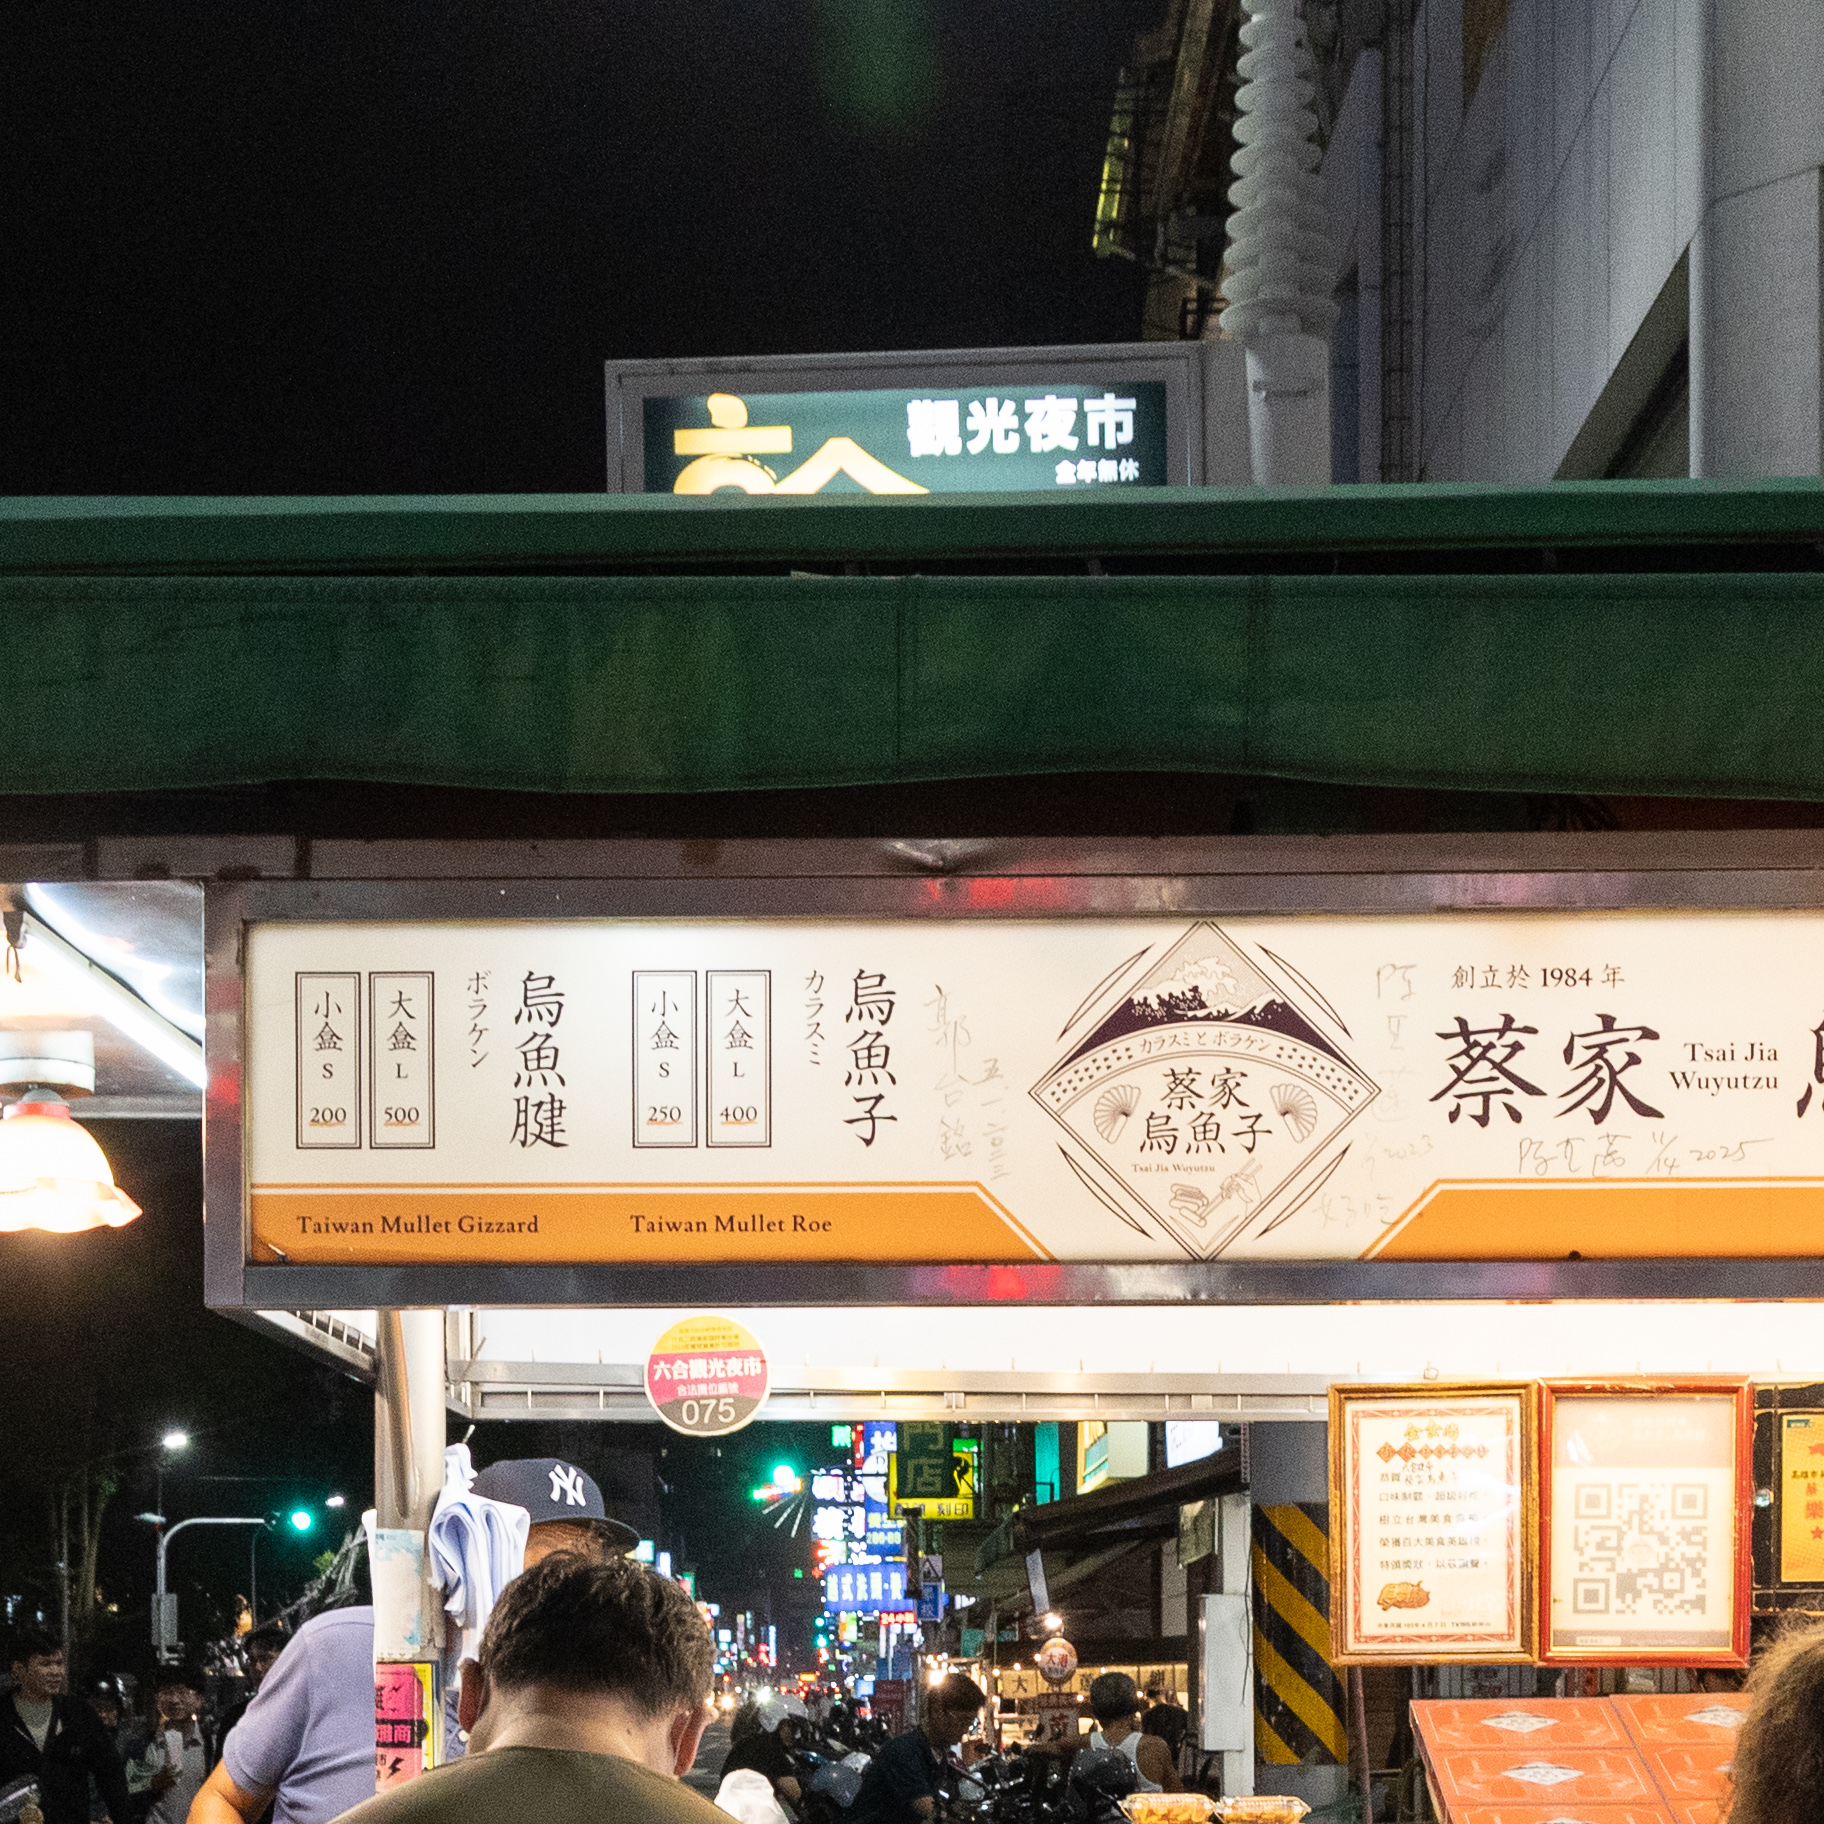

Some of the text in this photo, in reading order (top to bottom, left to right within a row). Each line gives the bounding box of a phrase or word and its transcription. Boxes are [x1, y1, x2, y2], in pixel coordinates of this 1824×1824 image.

[906, 393, 1136, 457] 觀光夜市
[1055, 459, 1139, 484] 全年無休
[1452, 963, 1625, 990] 創立於 1984 年
[466, 971, 489, 1069] ボラケン
[805, 969, 826, 1066] カラスミ
[309, 990, 347, 1124] 小盒 S 200
[383, 989, 420, 1124] 大盒 L 500
[510, 970, 568, 1149] 烏魚腱
[647, 990, 682, 1123] 小盒 S 250
[720, 988, 758, 1123] 大盒 L 400
[844, 968, 898, 1148] 烏魚子
[1429, 1013, 1665, 1129] 蔡家
[1684, 1043, 1778, 1062] Tsai Jia
[1161, 1066, 1250, 1115] 蔡家
[1669, 1072, 1778, 1095] Wuyutzu
[1139, 1106, 1273, 1156] 烏魚子
[1131, 1163, 1153, 1173] Tsai
[1154, 1163, 1169, 1173] Jia
[296, 1214, 539, 1234] Taiwan Mullet Gizzard
[629, 1213, 832, 1233] Taiwan Mullet Roe
[654, 1356, 762, 1381] 六合觀光夜市
[681, 1398, 736, 1424] 075
[548, 1464, 587, 1507] NY
